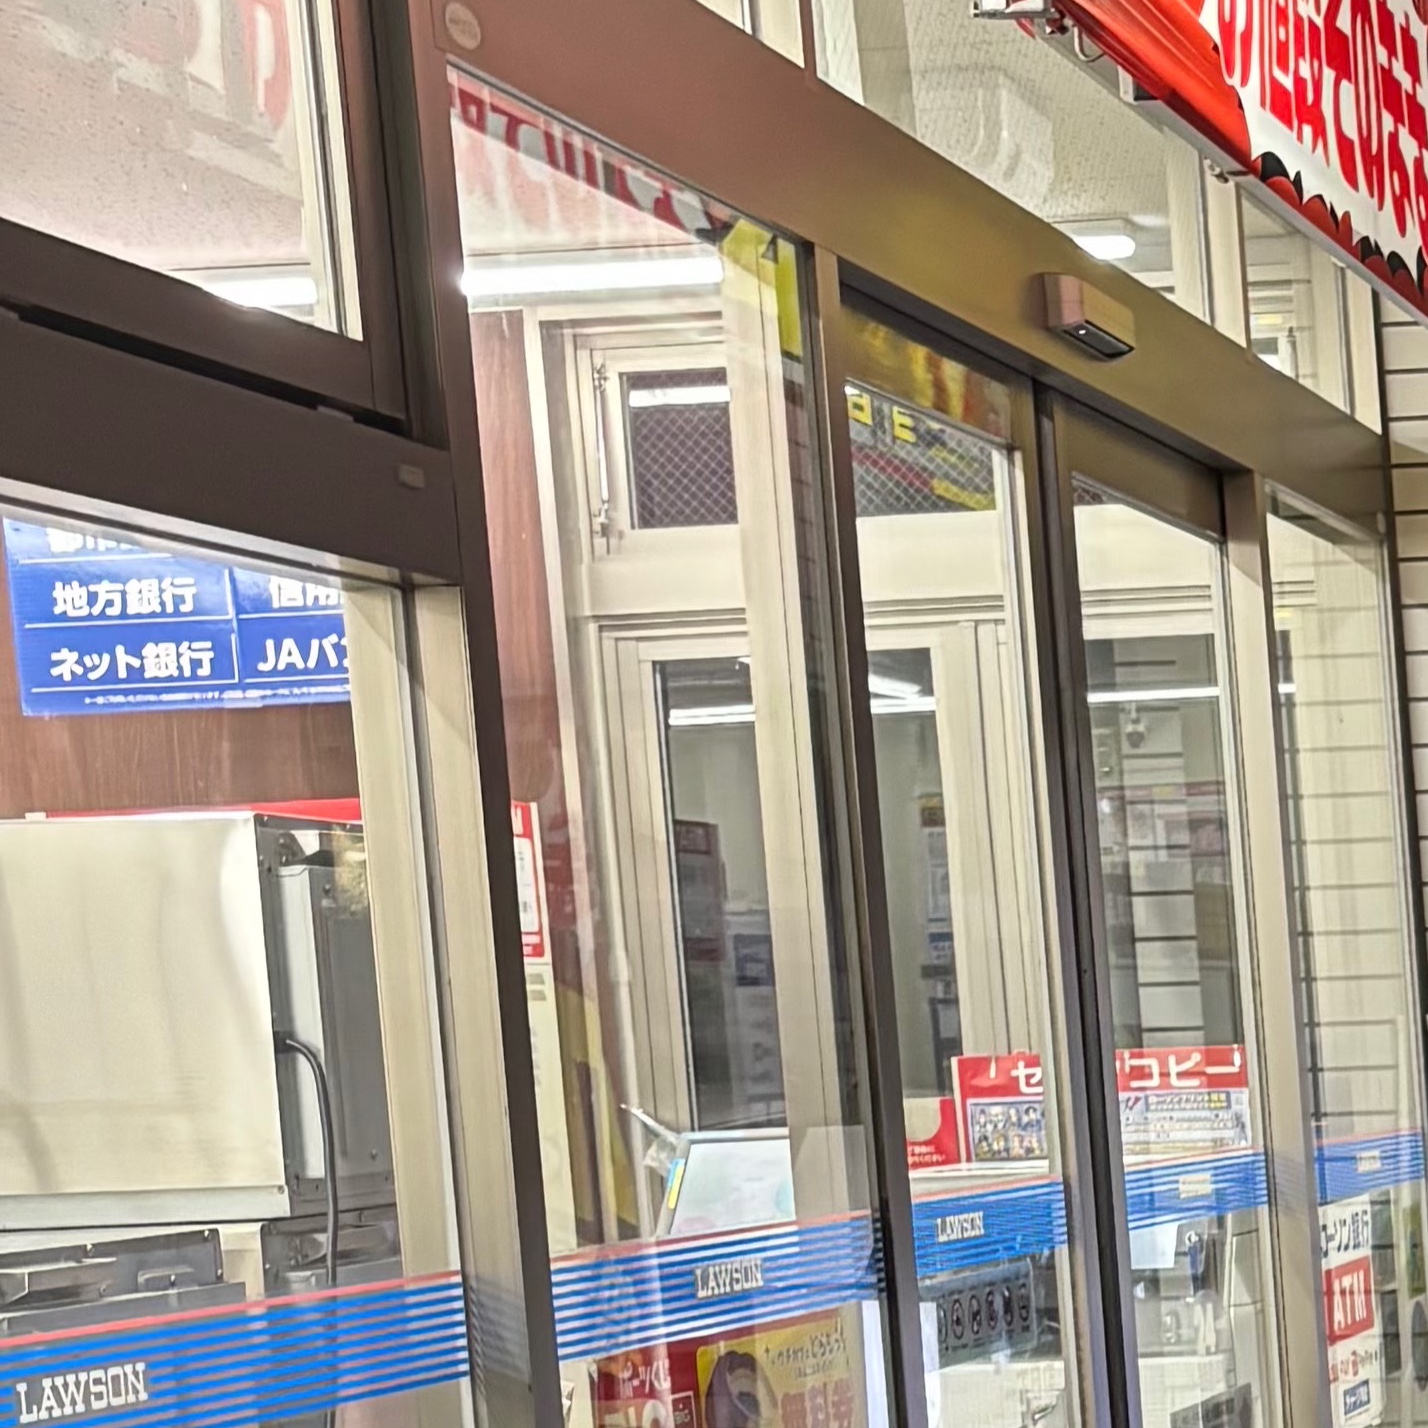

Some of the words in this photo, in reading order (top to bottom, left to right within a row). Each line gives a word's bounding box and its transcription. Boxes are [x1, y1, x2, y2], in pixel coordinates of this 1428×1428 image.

[53, 576, 198, 618] 地方銀行
[268, 574, 346, 609] 信用
[49, 640, 215, 682] ネット銀行
[256, 632, 349, 672] JAバ
[936, 1210, 985, 1244] LAWSON
[694, 1258, 765, 1300] LAWSON
[1332, 1268, 1368, 1332] ATM
[14, 1360, 151, 1425] LAWSON
